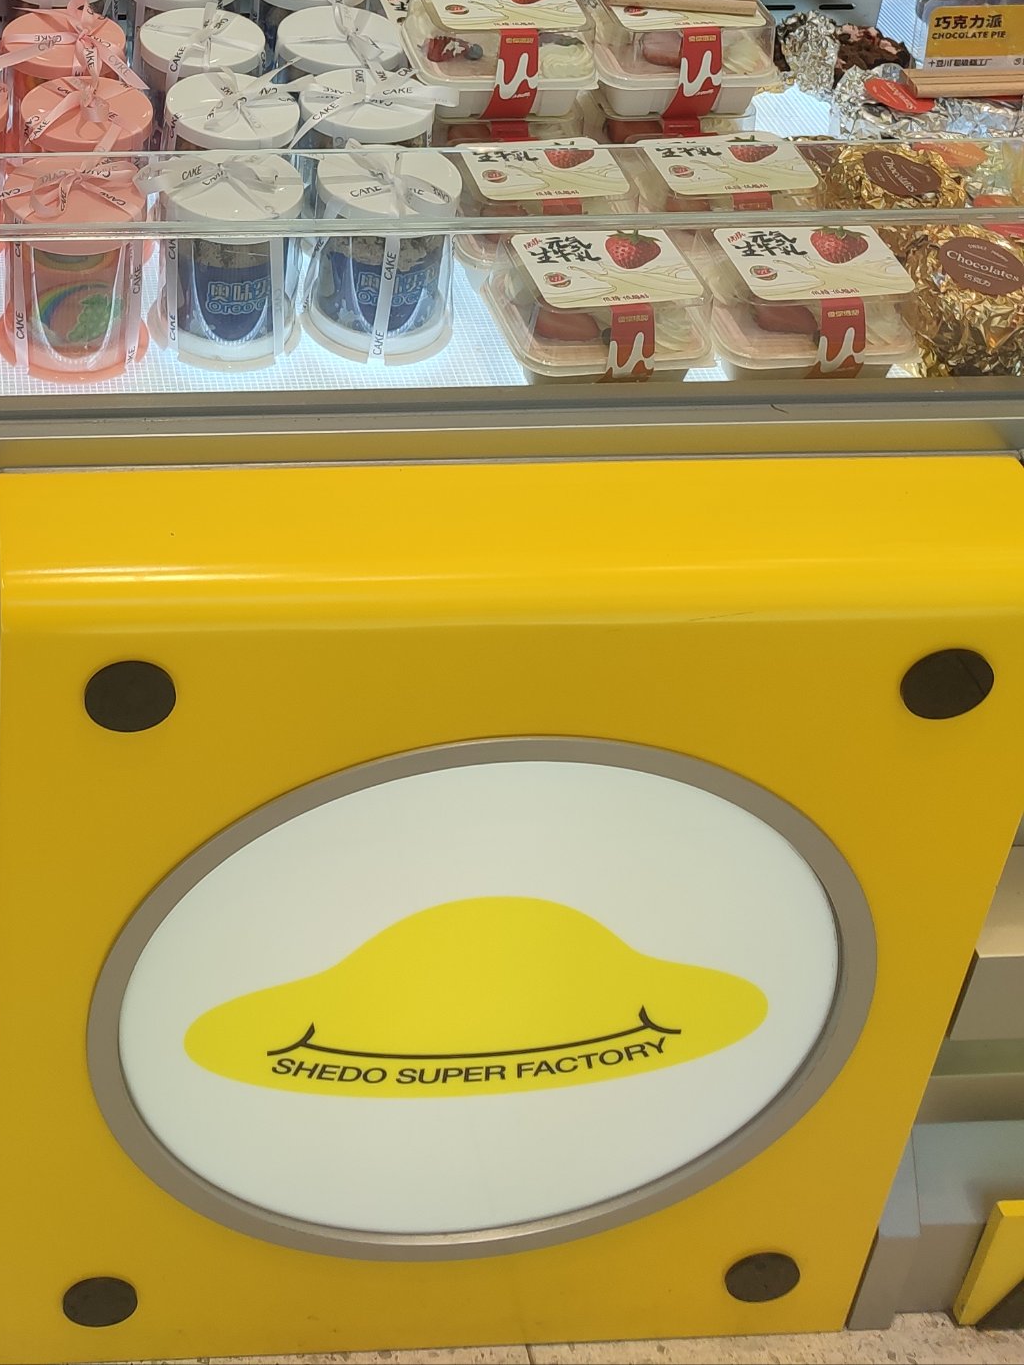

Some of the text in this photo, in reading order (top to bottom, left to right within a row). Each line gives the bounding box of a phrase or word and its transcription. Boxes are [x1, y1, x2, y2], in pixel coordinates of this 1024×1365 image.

[932, 30, 1007, 40] CHOCOLATE PIE
[934, 14, 1002, 30] 巧克力派
[34, 34, 63, 43] CAKE
[169, 45, 186, 73] CAKE
[354, 69, 366, 84] CAKE
[382, 85, 414, 97] CAKE
[312, 102, 340, 122] CAKE
[181, 165, 203, 181] CAKE
[383, 250, 398, 281] CAKE
[946, 249, 1020, 282] Chocolates
[132, 264, 142, 295] CAKE
[15, 311, 26, 340] CAKE
[169, 314, 177, 341] CAKE
[372, 330, 385, 356] CAKE
[271, 1036, 667, 1085] SHEDO SUPER FACTORY
